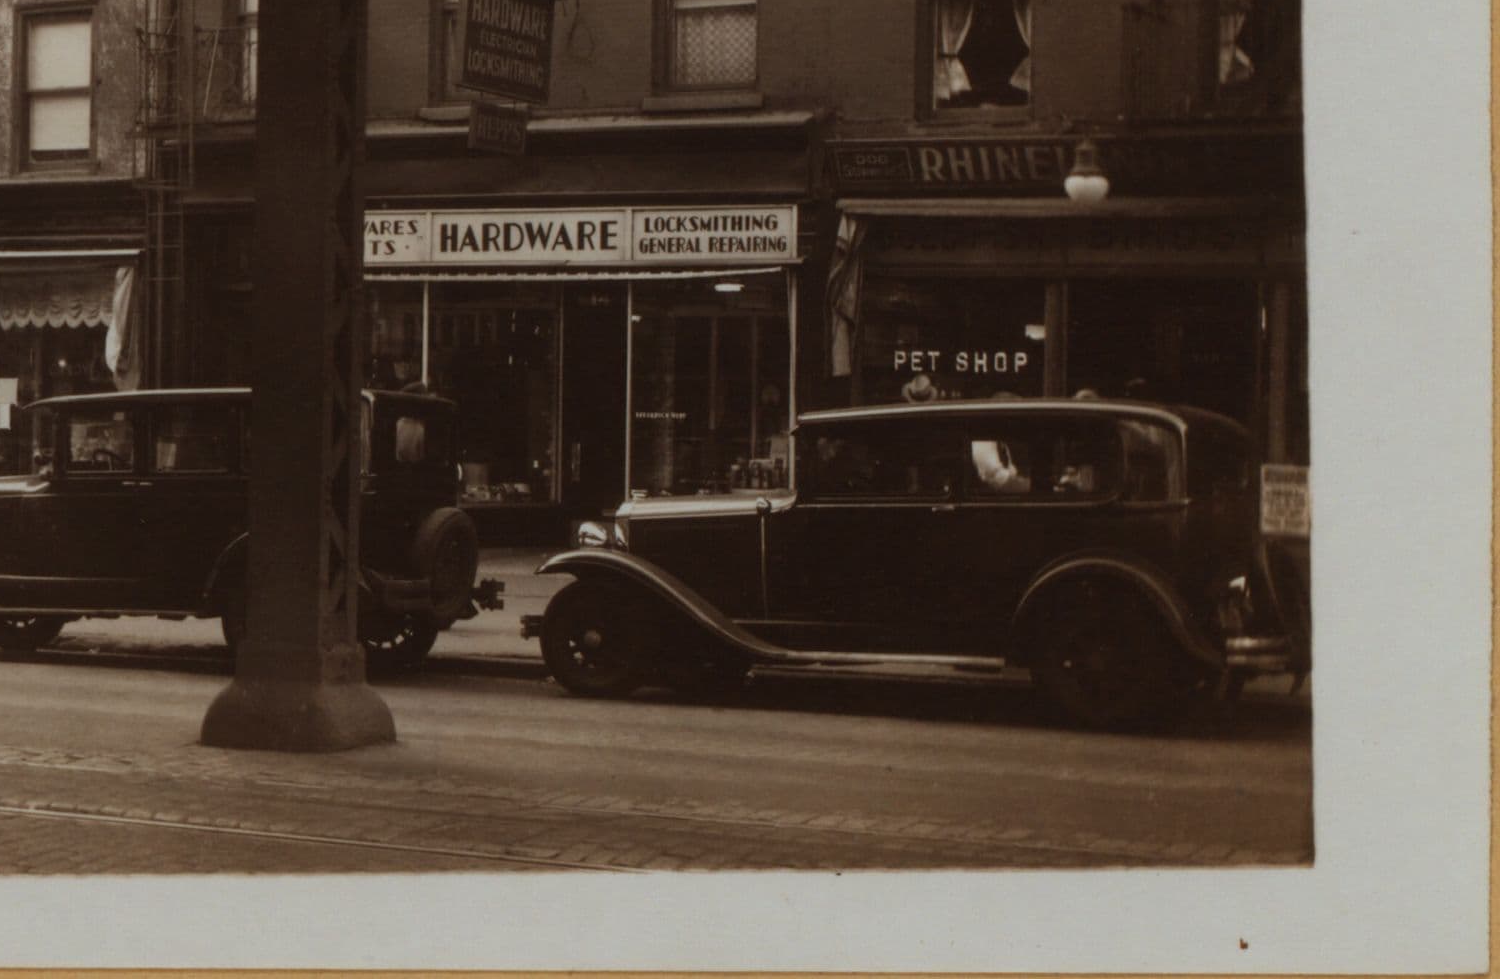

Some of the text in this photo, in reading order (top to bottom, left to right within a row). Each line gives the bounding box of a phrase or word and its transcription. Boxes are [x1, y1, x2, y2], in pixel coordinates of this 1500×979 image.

[643, 215, 778, 233] LOCKSMITHING
[439, 220, 618, 253] HARDWARE
[638, 234, 787, 254] GENERAL REPAIRING
[893, 349, 1029, 374] PET SHOP
